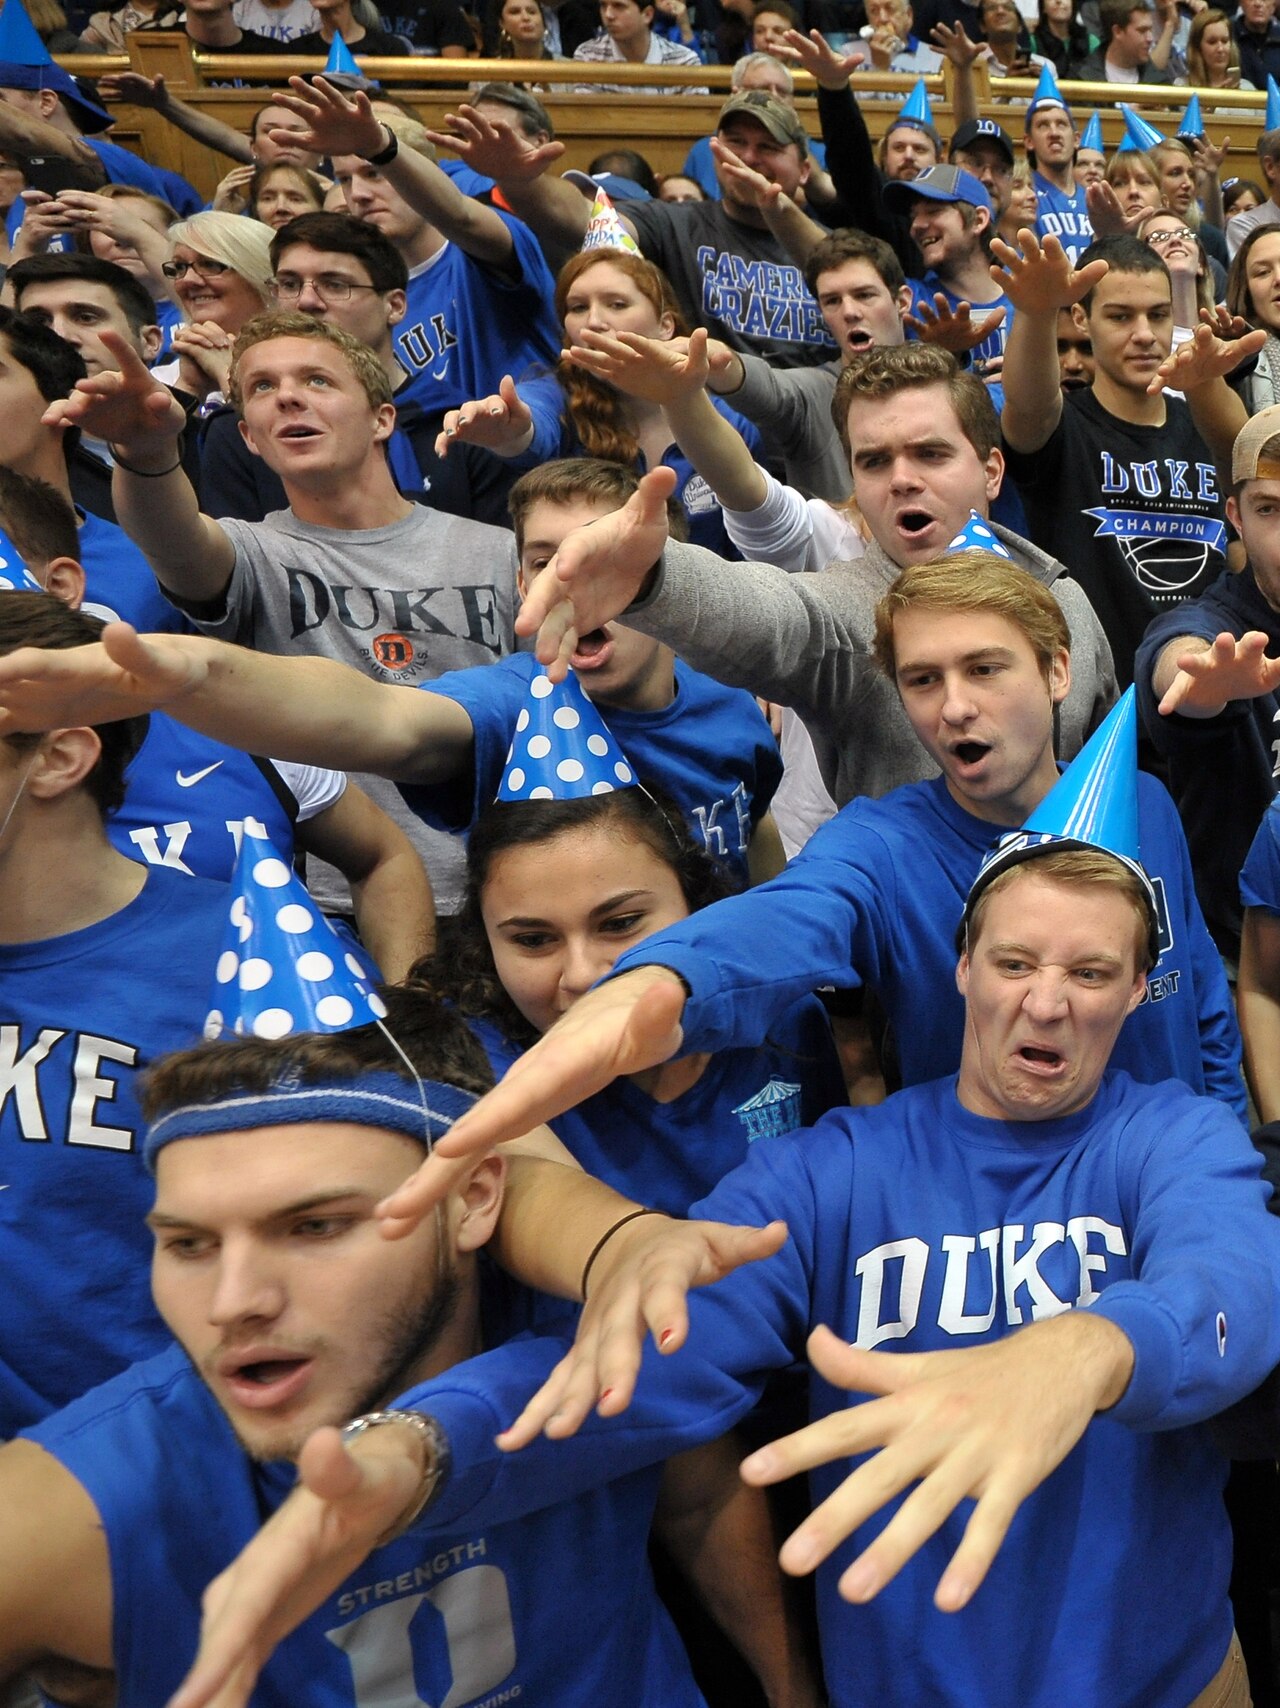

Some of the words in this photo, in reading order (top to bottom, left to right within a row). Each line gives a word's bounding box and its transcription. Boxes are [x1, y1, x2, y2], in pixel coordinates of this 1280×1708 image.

[1041, 212, 1095, 236] DUK
[697, 245, 817, 303] CAMER
[1100, 451, 1219, 503] DUKE
[1113, 518, 1205, 535] CHAMPION
[279, 562, 502, 657] DUKE
[848, 1215, 1128, 1351] DUKE
[336, 1537, 487, 1616] STRENGTH
